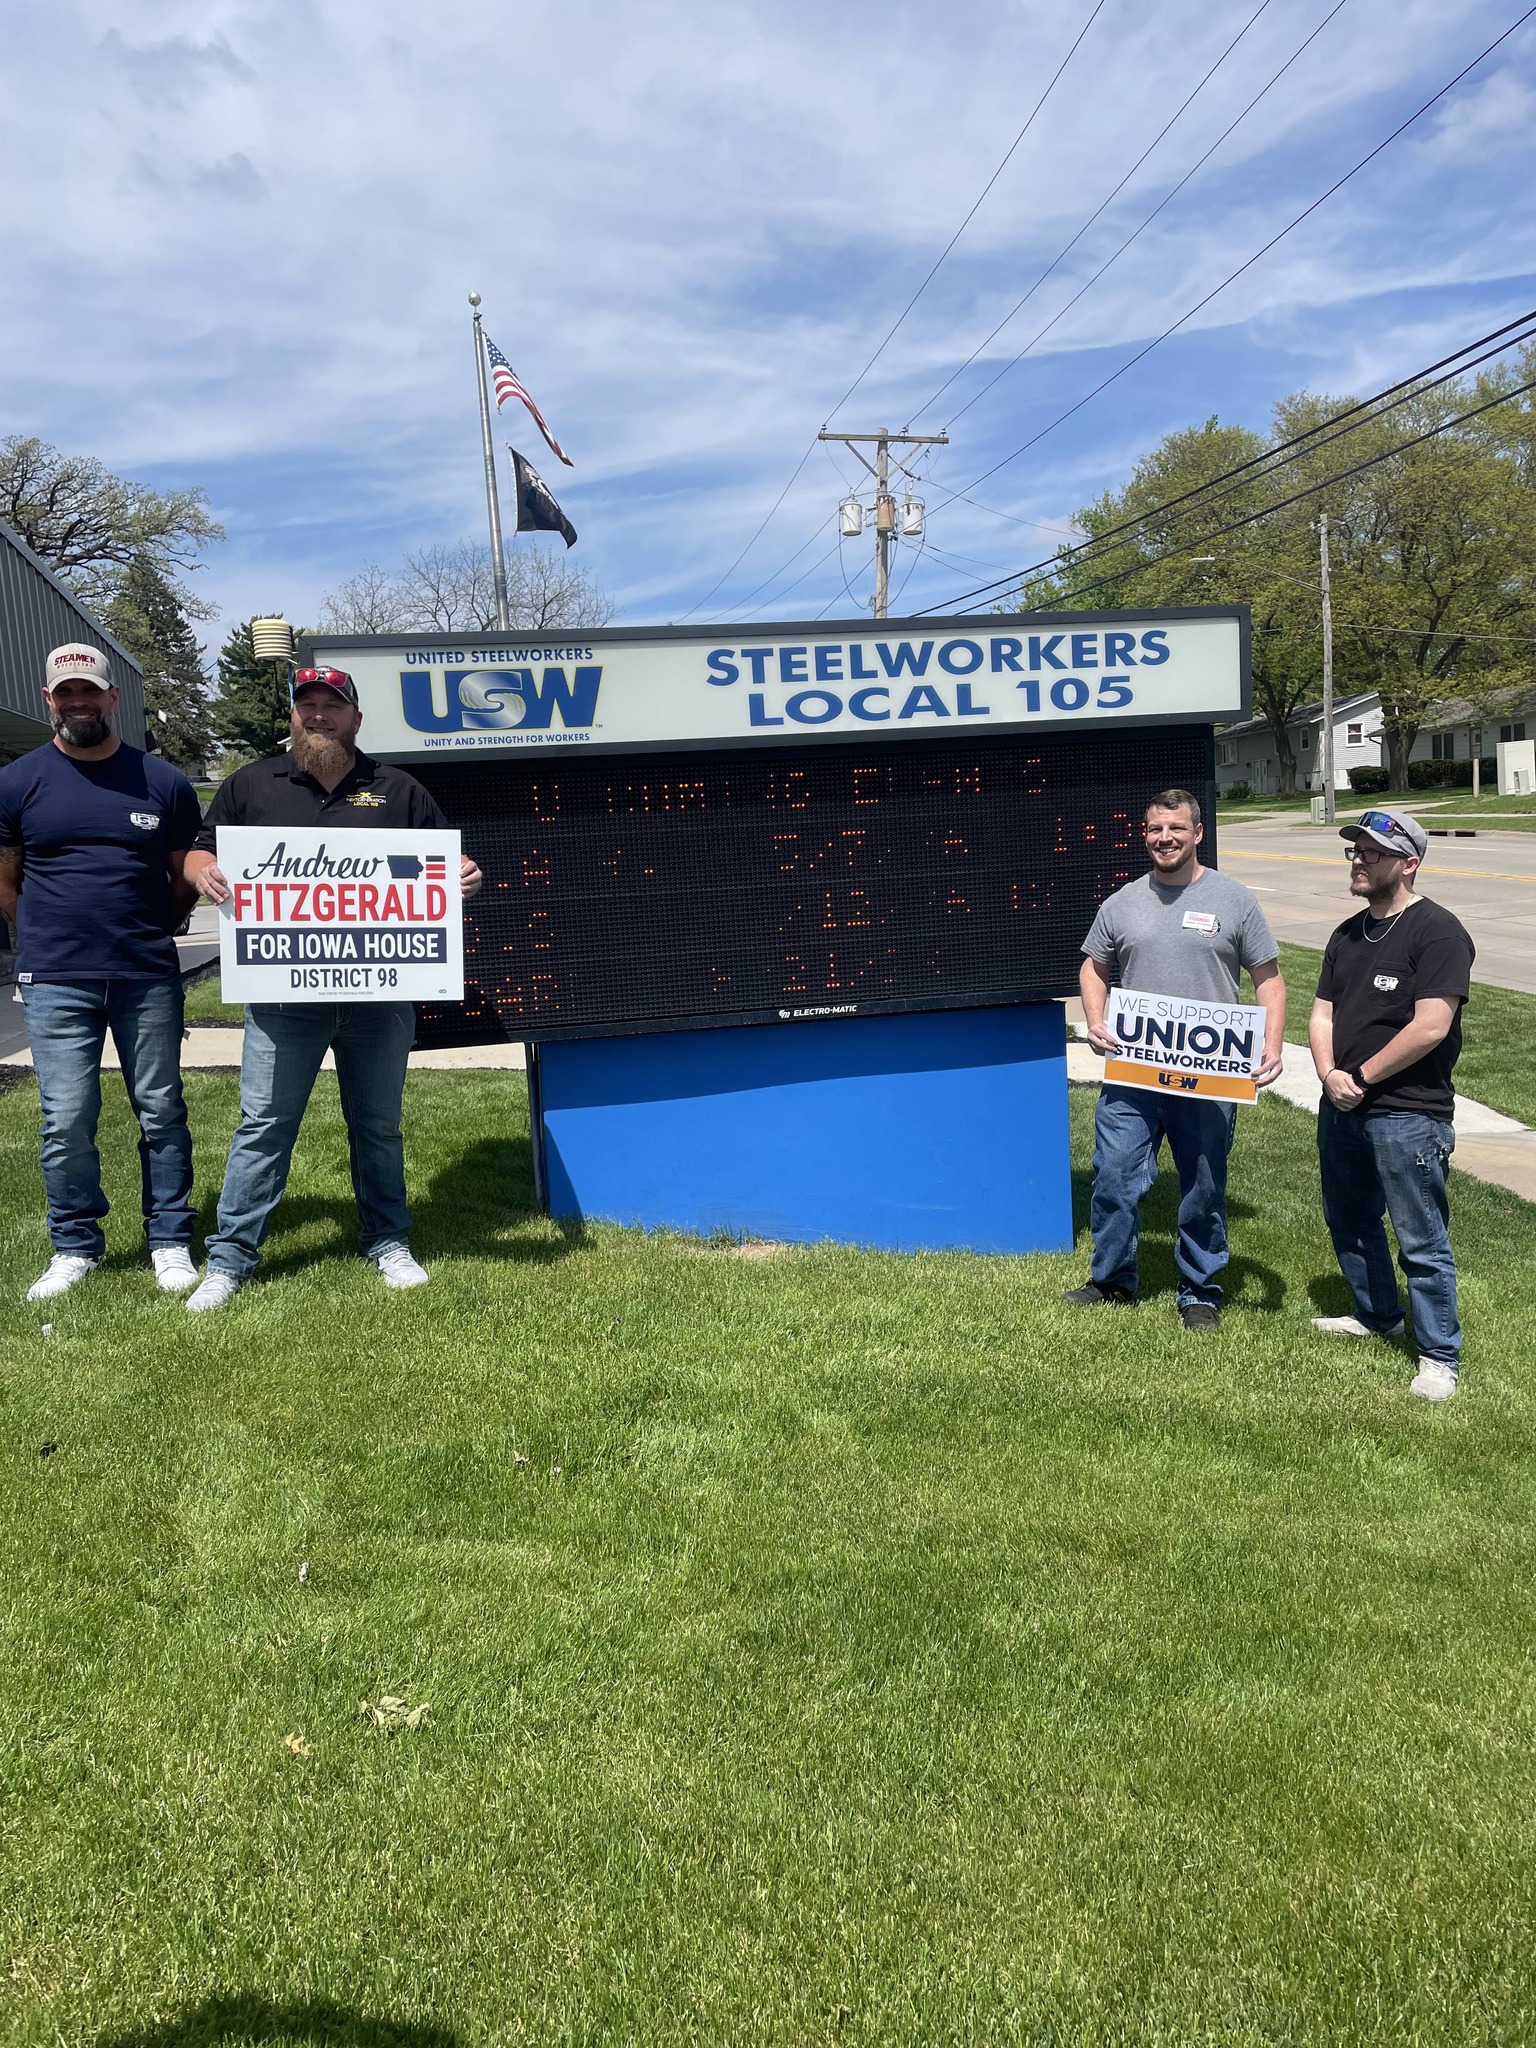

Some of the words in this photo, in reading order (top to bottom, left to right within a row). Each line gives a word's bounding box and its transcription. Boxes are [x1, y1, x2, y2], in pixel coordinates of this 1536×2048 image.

[54, 653, 96, 666] STEAMER
[406, 651, 465, 664] UNITED
[471, 648, 593, 663] STEELWORKERS
[706, 630, 1170, 686] STEELWORKERS
[400, 666, 603, 733] USW
[748, 683, 990, 727] LOCAL
[1015, 675, 1134, 712] 105
[424, 738, 452, 747] UNITY
[455, 737, 475, 746] AND
[478, 735, 523, 745] STRENGTH
[526, 734, 544, 743] FOR
[546, 733, 590, 743] WORKERS
[243, 841, 384, 880] Andrew
[234, 883, 447, 922] FITZGERALD
[246, 933, 291, 959] FOR
[298, 932, 357, 959] IOWA
[364, 933, 439, 958] HOUSE
[290, 968, 372, 988] DISTRICT
[378, 967, 398, 987] 98
[1118, 995, 1150, 1014] WE
[1156, 1001, 1257, 1027] SUPPORT
[1116, 1013, 1254, 1058] UNION
[1115, 1044, 1252, 1073] STEELWORKERS
[1158, 1072, 1199, 1090] USW
